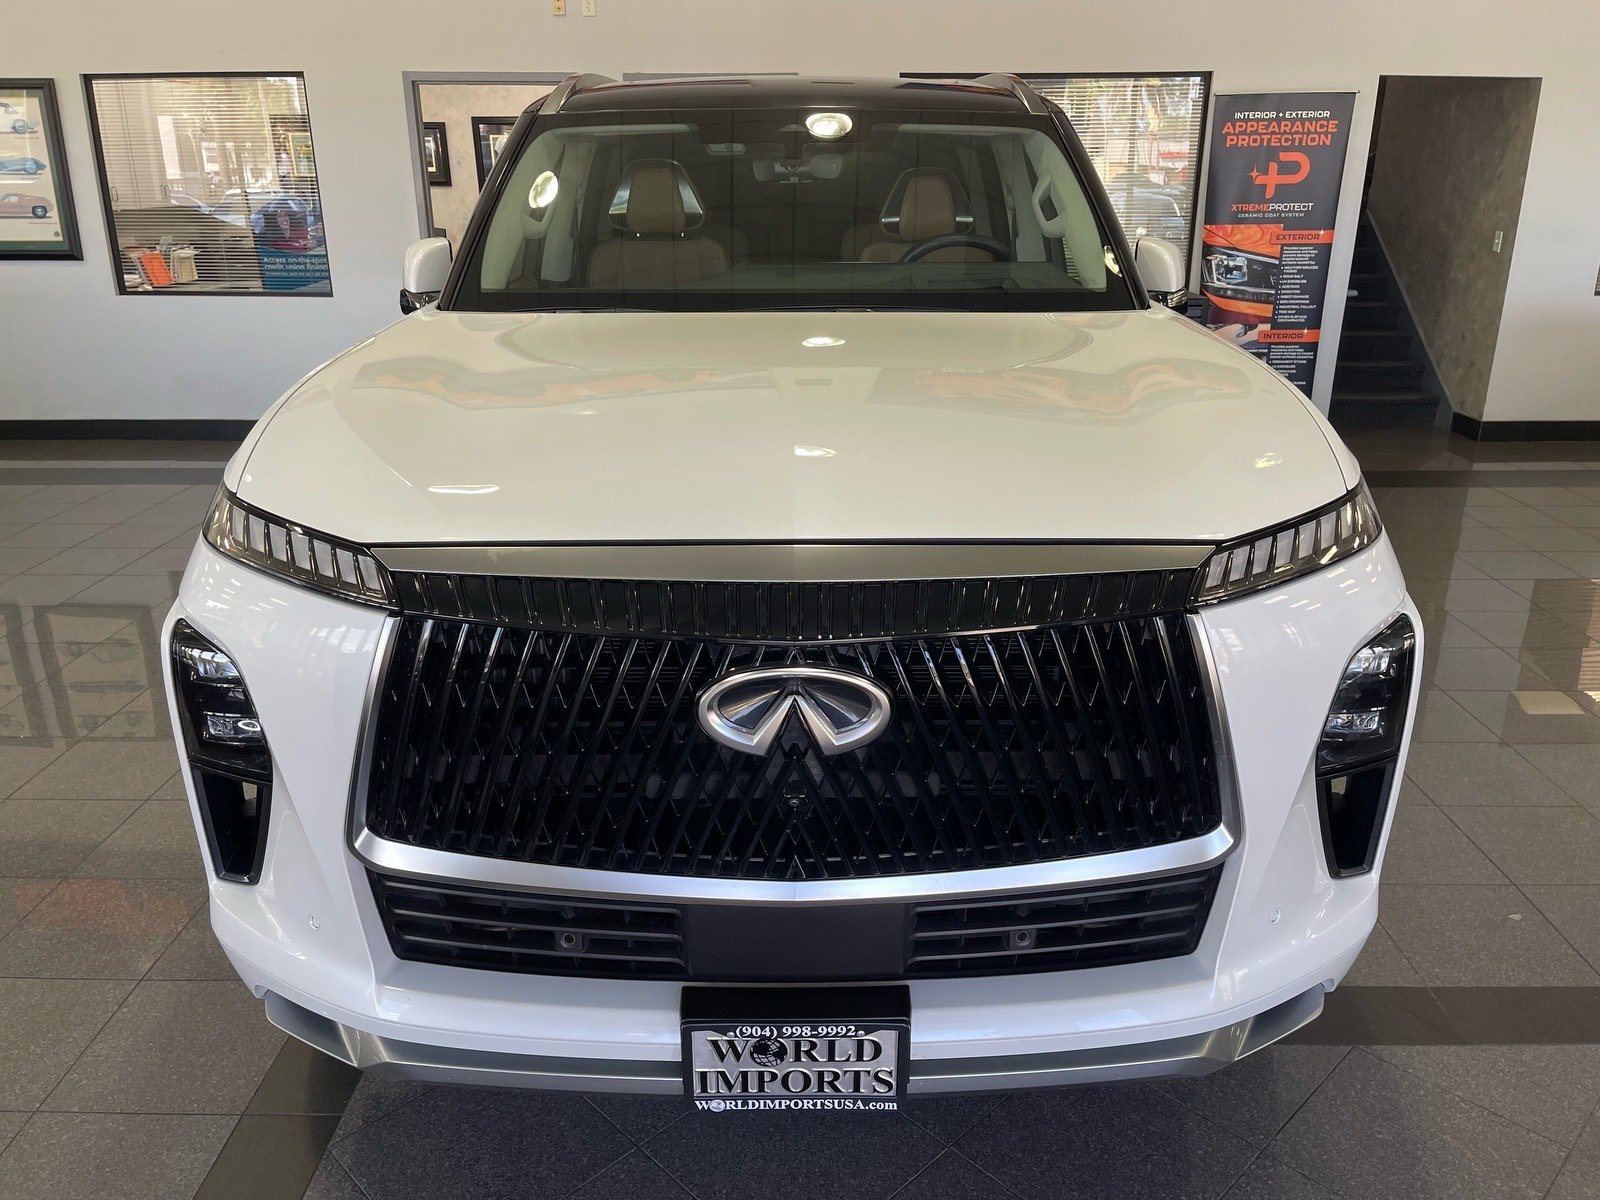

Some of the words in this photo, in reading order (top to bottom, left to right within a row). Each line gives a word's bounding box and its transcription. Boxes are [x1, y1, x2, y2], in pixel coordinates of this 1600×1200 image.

[1222, 120, 1338, 134] APPEARANCE
[1226, 134, 1332, 147] PROTECTION
[1231, 202, 1314, 211] XTREMEPROTECT
[736, 1026, 778, 1038] (904)
[782, 1026, 856, 1036] 998-9992
[695, 1068, 894, 1094] IMPORTS
